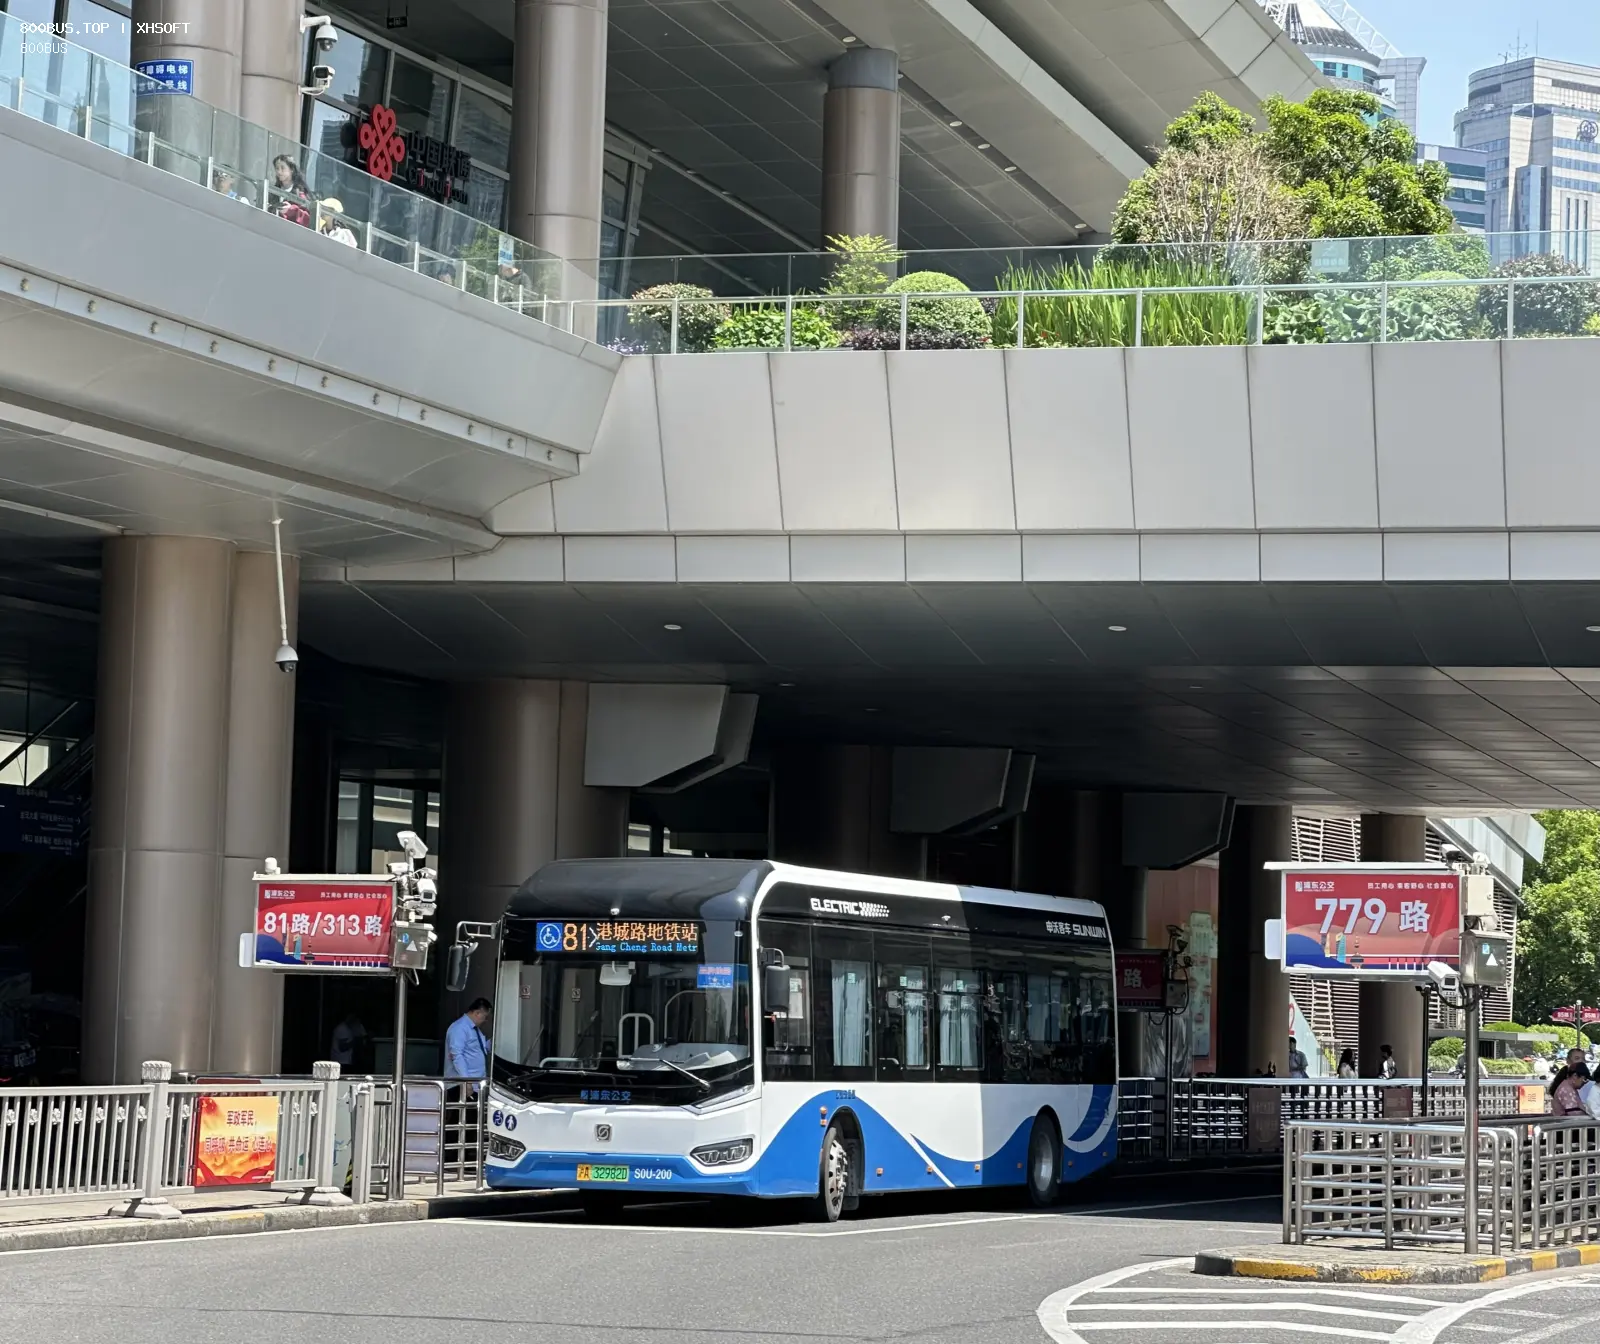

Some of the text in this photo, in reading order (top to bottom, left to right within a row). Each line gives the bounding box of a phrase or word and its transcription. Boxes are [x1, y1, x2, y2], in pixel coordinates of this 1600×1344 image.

[408, 130, 472, 182] 中国联通
[810, 897, 859, 915] ELECTRIC
[562, 922, 699, 951] 81 港城路地铁站
[1072, 923, 1107, 939] SUNWIN
[620, 942, 647, 953] Cheng
[651, 942, 673, 952] Road
[1123, 967, 1142, 988] 路
[590, 1089, 631, 1101] 浦东公交
